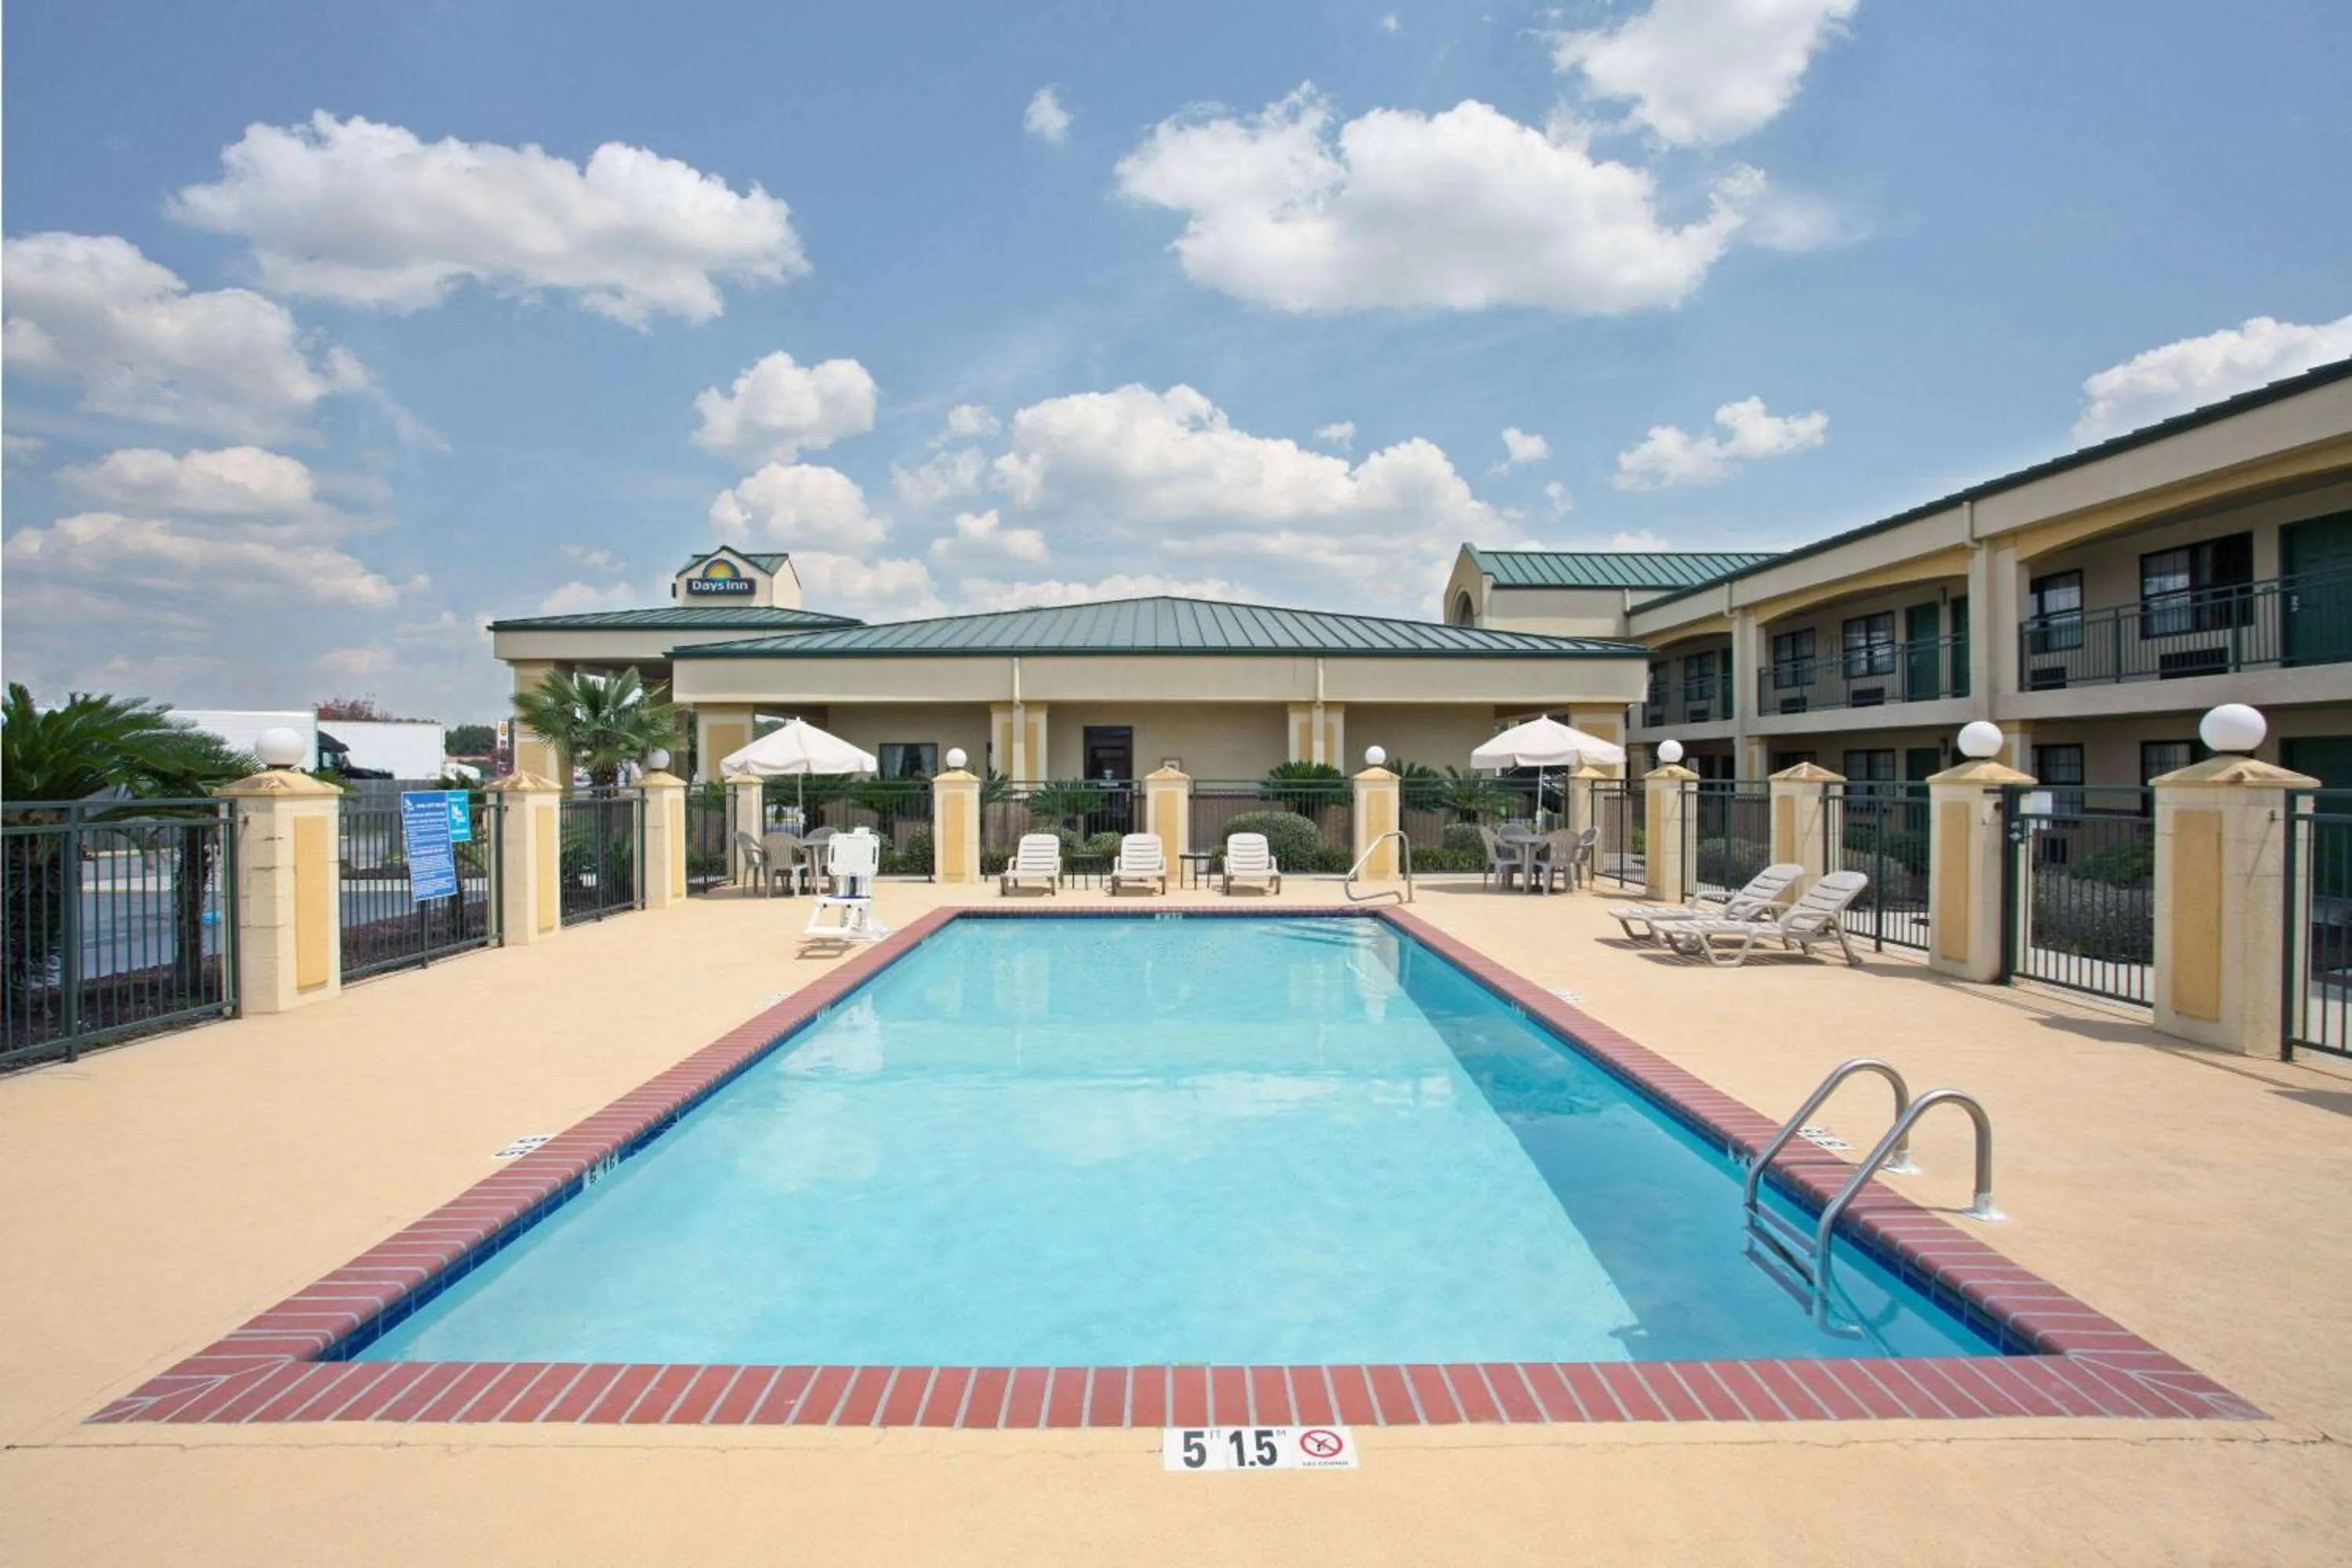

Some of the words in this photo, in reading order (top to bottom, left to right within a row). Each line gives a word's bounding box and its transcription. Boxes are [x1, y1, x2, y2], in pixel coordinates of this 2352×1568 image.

[692, 581, 724, 591] Days
[726, 580, 748, 590] Inn
[1183, 1431, 1207, 1468] 5
[1229, 1429, 1278, 1467] 1.5
